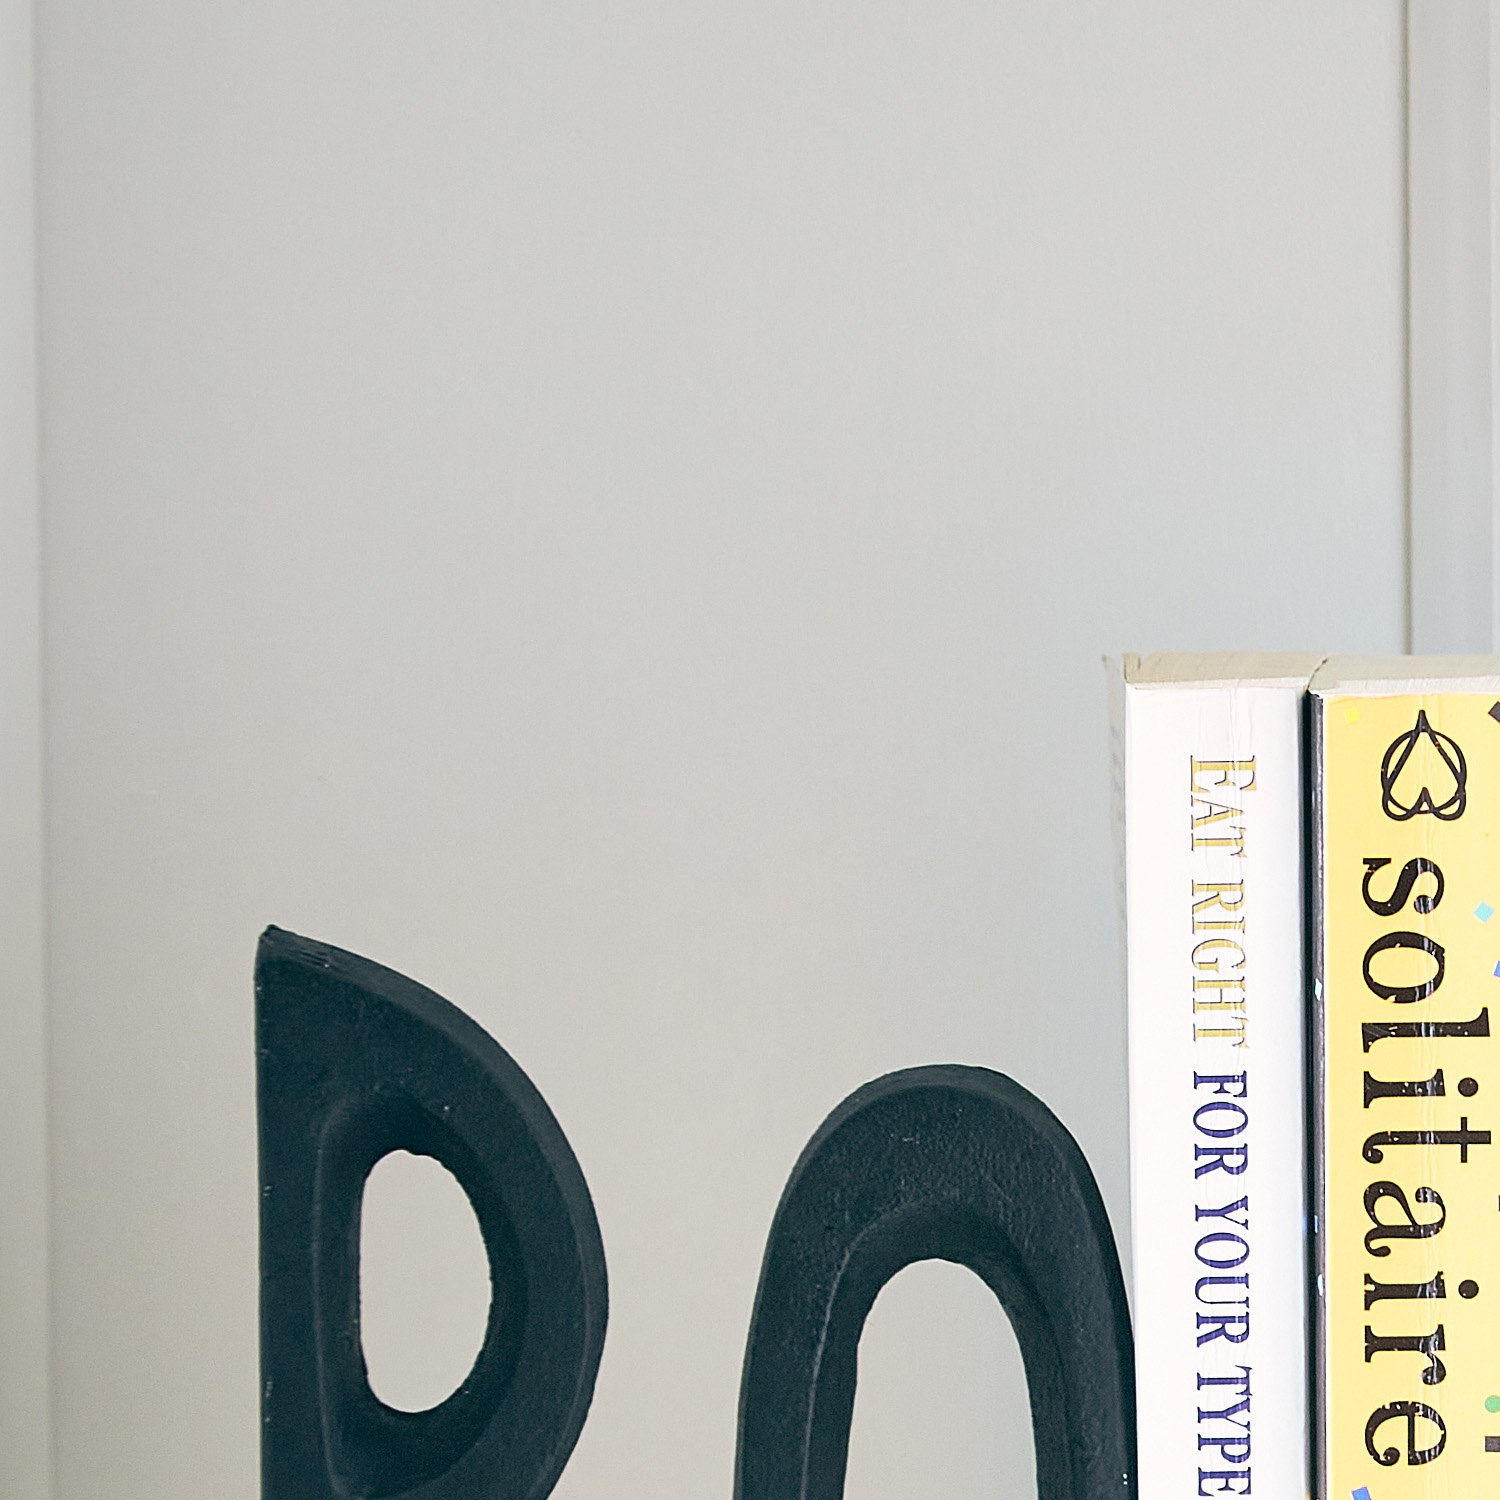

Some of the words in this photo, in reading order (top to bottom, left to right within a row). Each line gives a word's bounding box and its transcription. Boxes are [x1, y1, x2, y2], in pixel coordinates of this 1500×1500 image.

[1191, 755, 1257, 857] EAT
[1191, 879, 1249, 1048] RIGHT
[1193, 1070, 1248, 1179] FOR
[1361, 857, 1491, 1467] solitaire
[1194, 1195, 1250, 1348] YOUR
[1196, 1365, 1252, 1497] TYPE
